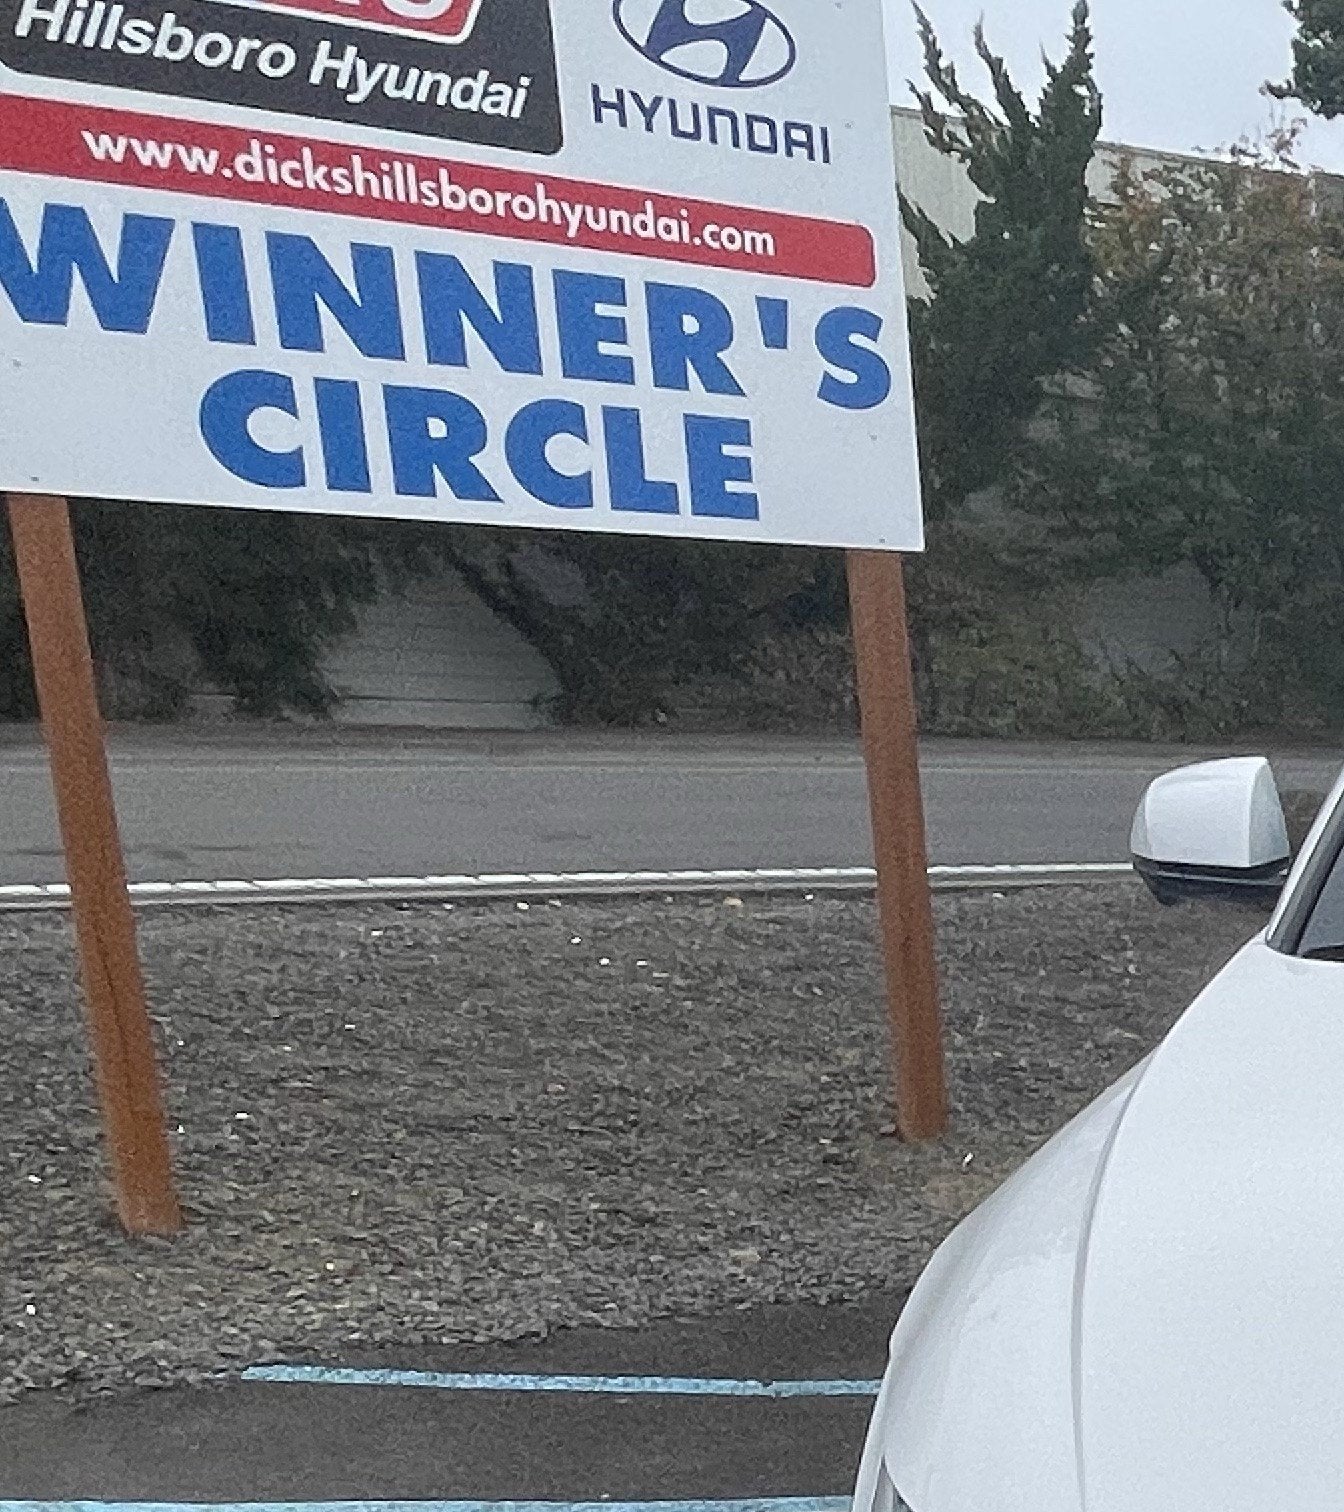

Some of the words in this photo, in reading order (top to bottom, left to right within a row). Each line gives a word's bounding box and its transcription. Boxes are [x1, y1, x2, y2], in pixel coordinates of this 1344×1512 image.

[15, 0, 297, 78] Hillsboro
[308, 40, 530, 118] Hyundai
[590, 83, 831, 164] HYUNDAI
[81, 130, 776, 257] www.dickshillsborohyundai.com
[0, 197, 891, 409] WINNER'S
[200, 368, 760, 520] CIRCLE
